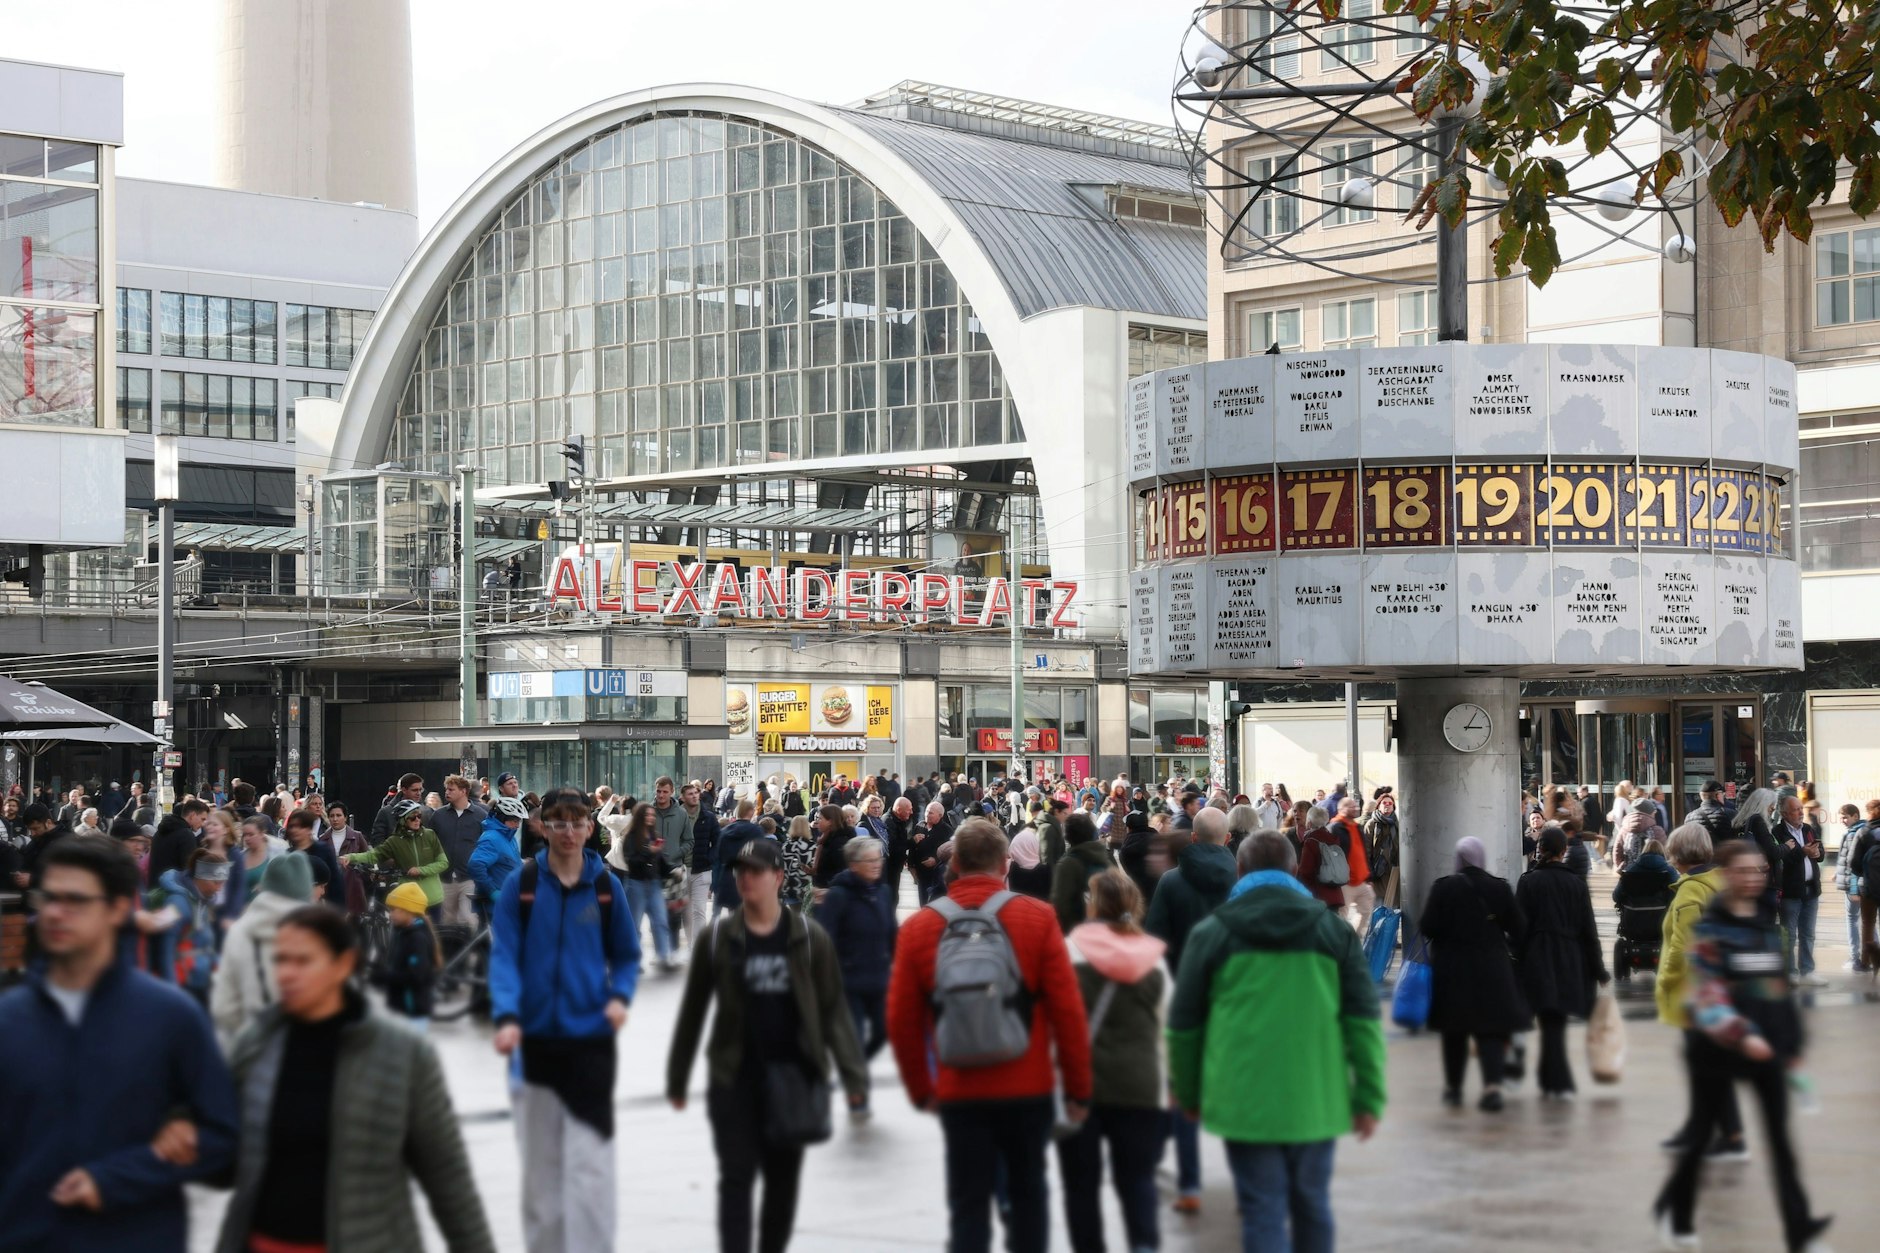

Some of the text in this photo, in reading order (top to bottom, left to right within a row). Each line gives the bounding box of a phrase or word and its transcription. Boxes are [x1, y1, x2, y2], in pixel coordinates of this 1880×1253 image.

[1287, 360, 1328, 371] NISCHNIJ
[1301, 369, 1345, 379] NOWGOROD
[1368, 365, 1443, 376] JEKATERINBURG
[1168, 374, 1190, 384] HELSINKI
[1376, 375, 1434, 385] ASCHGABAT
[1173, 385, 1185, 393] RIGA
[1726, 380, 1750, 390] JAKUTSK
[1219, 386, 1261, 398] MURMANSK
[1291, 390, 1342, 400] WOLGOGRAD
[1383, 387, 1428, 396] BISCHKEK
[1659, 387, 1690, 396] IRKUTSK
[1170, 394, 1189, 404] TALLINN
[1223, 394, 1264, 408] PETERSBURG
[1378, 397, 1434, 406] DUSCHANBE
[1473, 396, 1528, 404] TASCHKENT
[1172, 406, 1187, 414] WILNA
[1305, 402, 1327, 410] BAKU
[1224, 406, 1253, 417] MOSKAU
[1652, 408, 1697, 417] ULAN-BATOR
[1172, 415, 1187, 424] MINSK
[1304, 412, 1328, 421] TIFLIS
[1174, 424, 1185, 434] KIEW
[1300, 423, 1332, 432] ERIWAN
[1168, 434, 1192, 445] BUKAREST
[1173, 444, 1187, 455] SOFIA
[1171, 456, 1190, 465] NIKOSIA
[1174, 492, 1206, 542] 15
[1220, 486, 1268, 536] 16
[1286, 480, 1346, 531] 17
[1367, 478, 1431, 529] 18
[1456, 476, 1521, 526] 19
[1536, 476, 1612, 528] 20
[1624, 476, 1678, 528] 21
[1691, 480, 1740, 531] 22
[1744, 484, 1770, 534] 23
[1772, 489, 1780, 538] 2
[1172, 572, 1193, 580] ANKARA
[1216, 568, 1249, 577] TEHERAN
[1665, 573, 1691, 581] PEKING
[1171, 582, 1194, 591] ISTANBUL
[1228, 579, 1256, 587] BAGDAD
[1658, 583, 1698, 592] SHANGHAI
[546, 557, 1079, 628] ALEXANDERPLATZ
[1725, 584, 1756, 594] PJÖNGJANG
[1174, 593, 1190, 601] ATHEN
[1297, 596, 1342, 605] MAURITIUS
[1229, 600, 1254, 608] SANAA
[1734, 607, 1749, 615] SEOUL
[1169, 612, 1196, 623] JERUSALEM
[1174, 623, 1190, 632] BEIRUT
[1218, 620, 1266, 629] MOGADISCHU
[1169, 633, 1195, 642] DAMASKUS
[1219, 630, 1266, 639] DARESSALAM
[1214, 640, 1271, 649] ANTANANARIVO
[1170, 654, 1195, 662] KAPSTADT
[1230, 652, 1255, 660] KUWAIT
[641, 674, 652, 682] U8
[492, 674, 504, 696] U
[588, 672, 604, 694] U
[641, 685, 652, 694] U5
[760, 691, 796, 702] BURGER
[778, 702, 808, 712] MITTE?
[868, 700, 881, 708] ICH
[14, 706, 76, 715] Tchibo
[868, 708, 889, 716] LIEBE
[760, 713, 788, 724] BITTE!
[869, 717, 881, 725] ES!
[627, 728, 684, 738] U Alexanderplatz
[1000, 732, 1040, 740] CURURST
[785, 736, 867, 751] McDonald's
